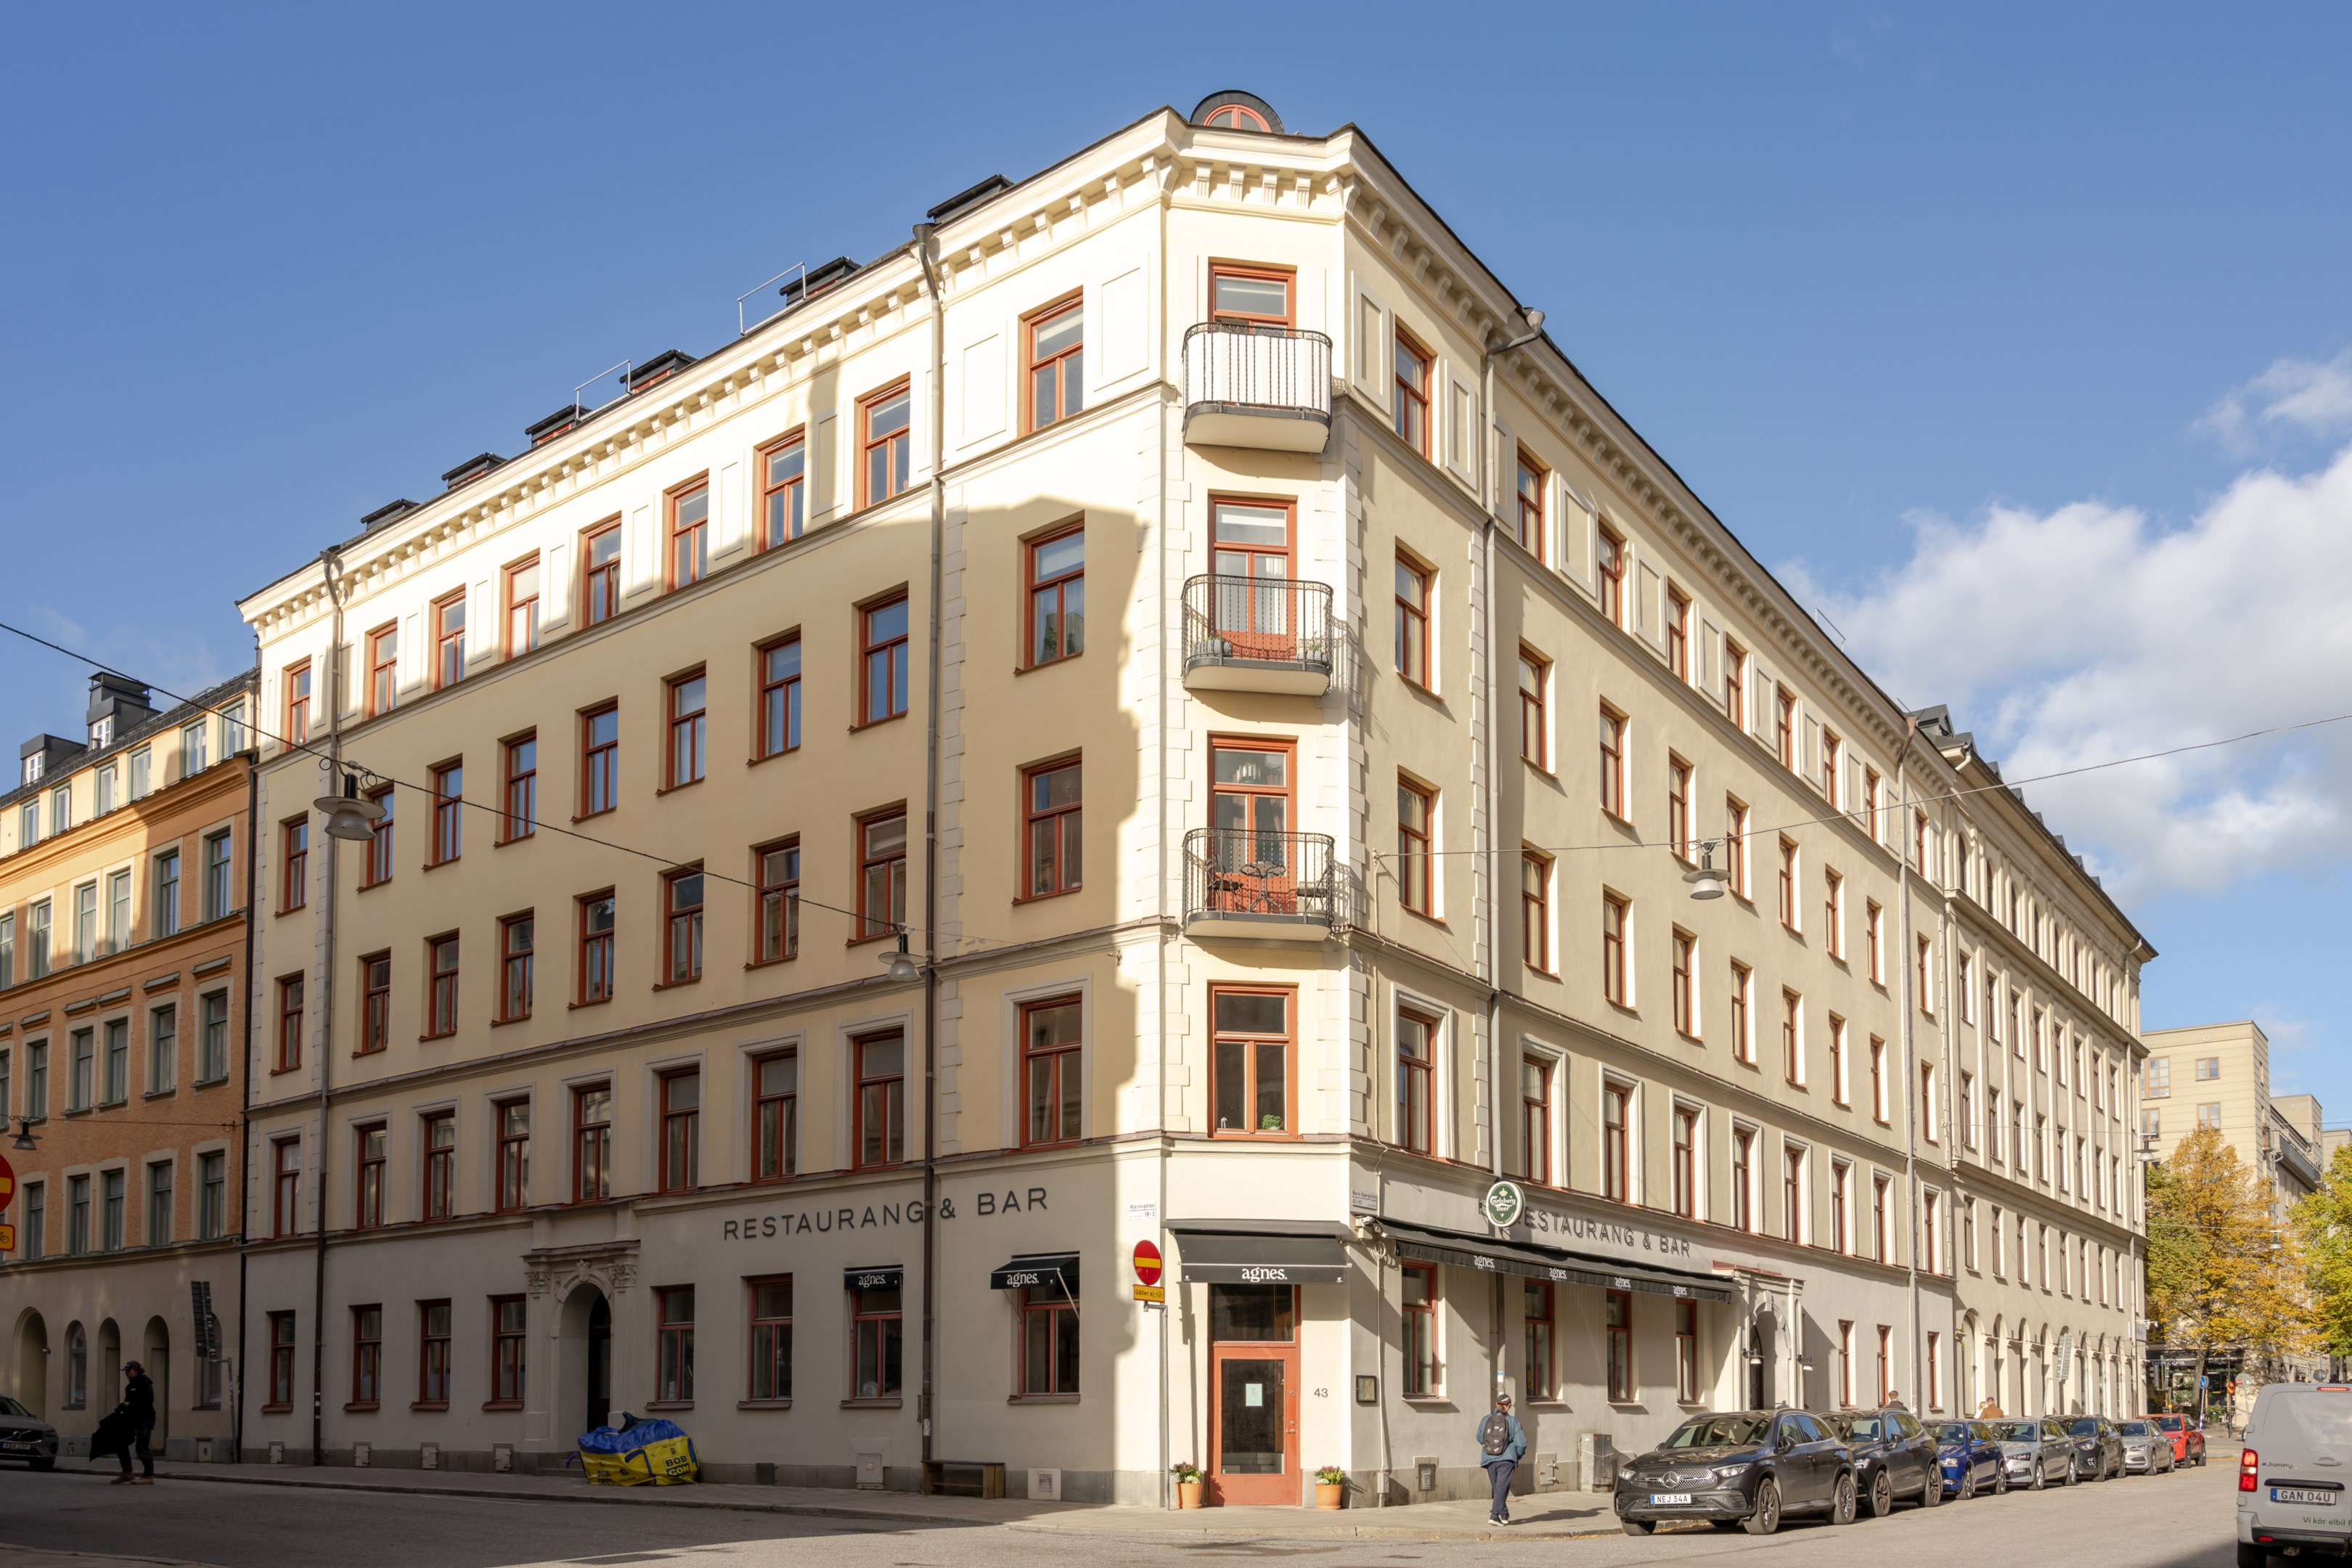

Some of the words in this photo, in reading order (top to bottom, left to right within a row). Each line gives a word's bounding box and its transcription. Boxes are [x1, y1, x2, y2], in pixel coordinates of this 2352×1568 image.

[1490, 1196, 1516, 1206] Carlsberg
[724, 1201, 924, 1241] RESTAURANG
[940, 1198, 956, 1219] &
[978, 1187, 1048, 1216] BAR
[1524, 1206, 1633, 1247] ESTAURANG
[1643, 1231, 1651, 1251] &
[1660, 1234, 1691, 1258] BAR
[859, 1274, 886, 1288] agnes.
[1007, 1273, 1039, 1287] agnes.
[1241, 1267, 1288, 1282] agnes.
[1314, 1388, 1328, 1397] 43
[665, 1455, 687, 1467] BOB
[668, 1464, 690, 1476] CON
[2281, 1490, 2303, 1500] GAN
